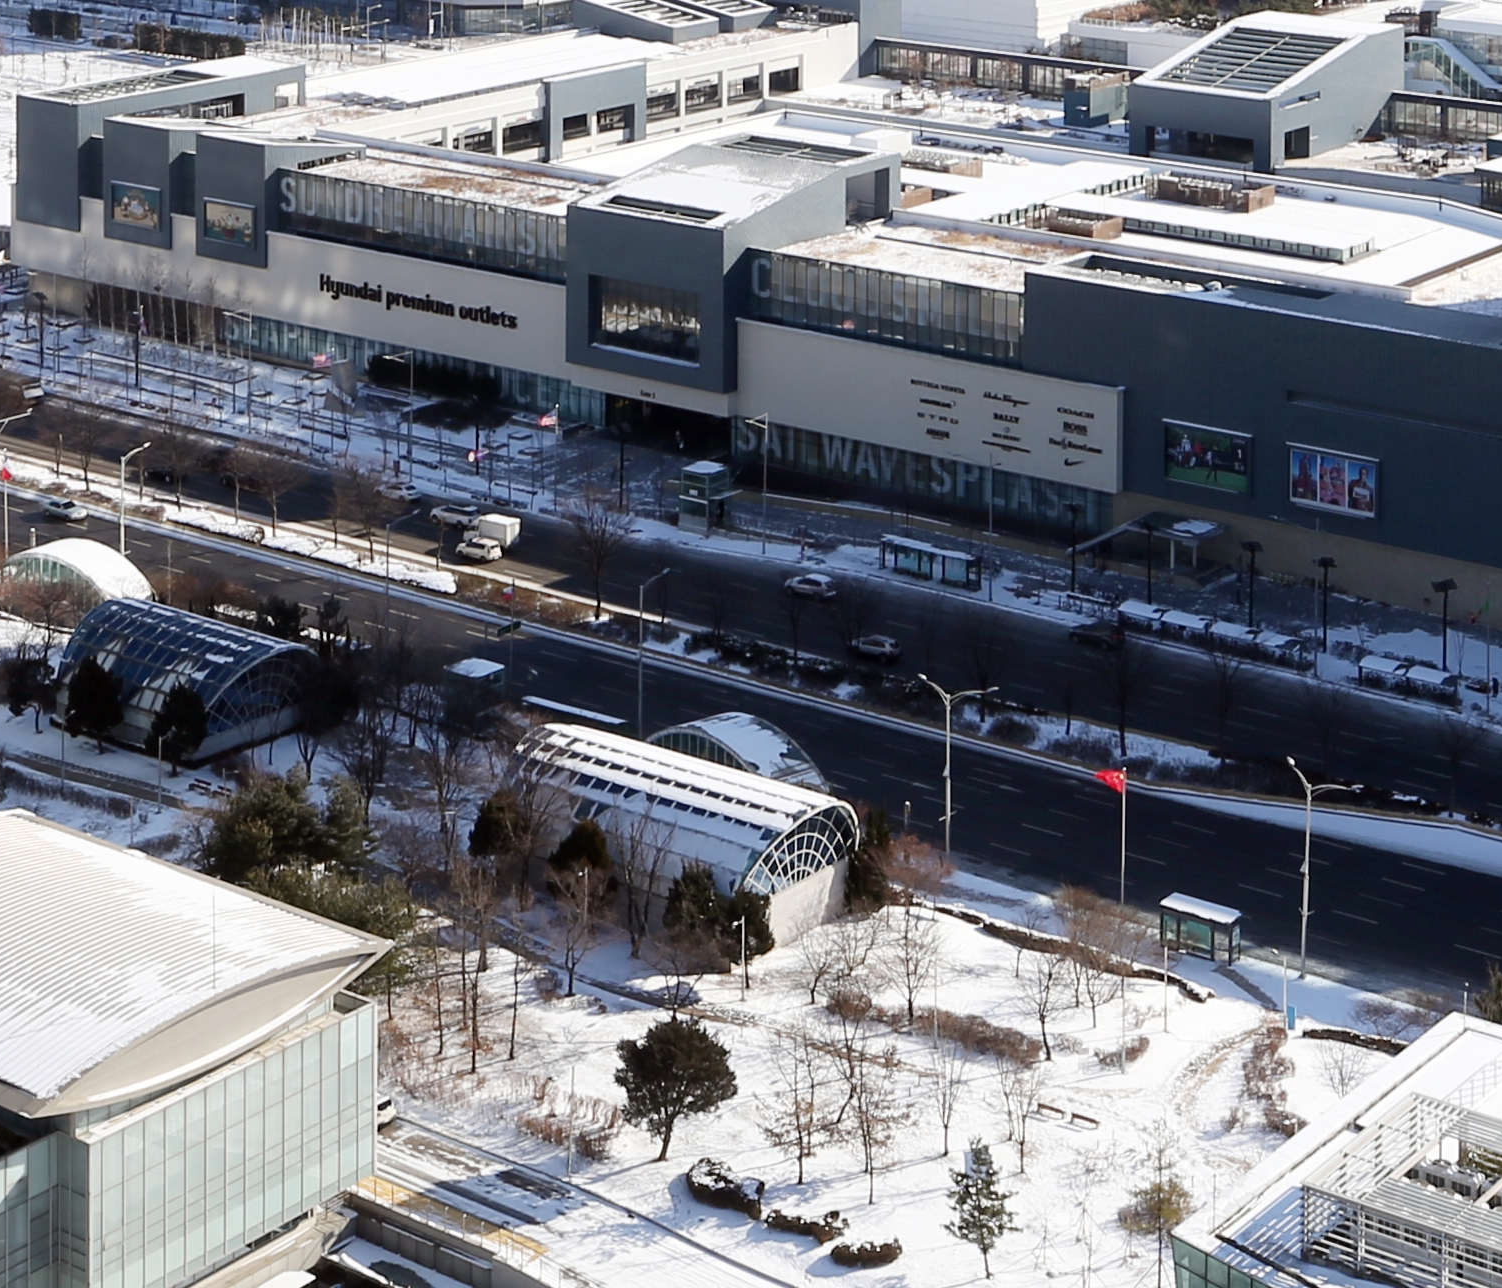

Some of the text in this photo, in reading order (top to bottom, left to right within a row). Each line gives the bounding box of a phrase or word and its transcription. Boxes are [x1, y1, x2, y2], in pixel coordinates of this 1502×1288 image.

[320, 274, 517, 329] Hyundai premium outlets
[992, 412, 1020, 424] BALLY
[1056, 406, 1095, 420] COACH
